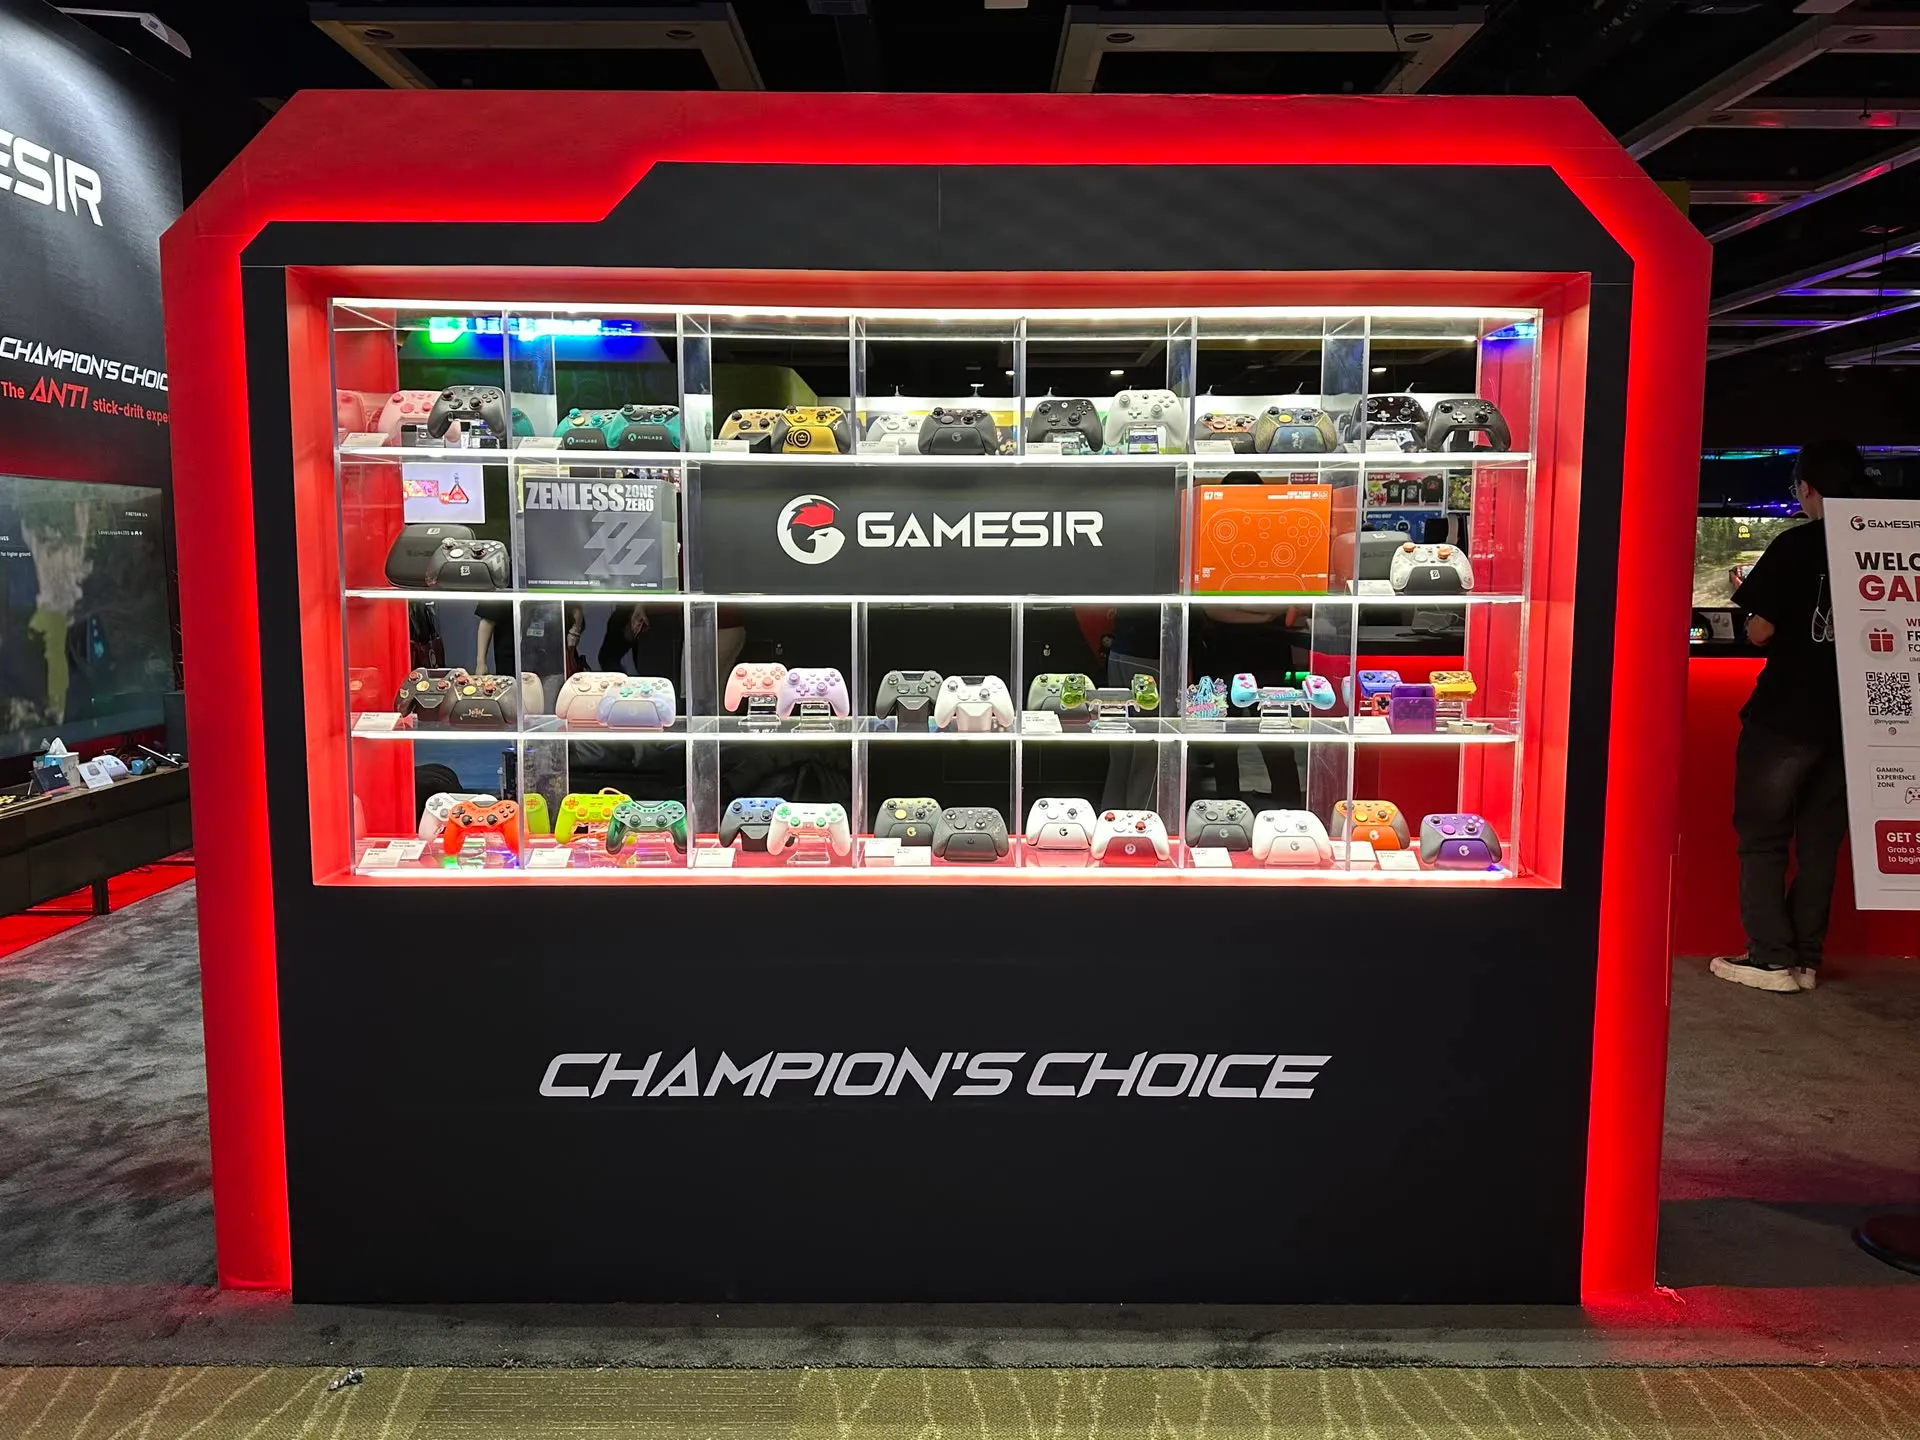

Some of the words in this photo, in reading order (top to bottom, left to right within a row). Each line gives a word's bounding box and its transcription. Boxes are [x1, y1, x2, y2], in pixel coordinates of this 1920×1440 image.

[0, 336, 121, 380] CHAMPION'S
[1, 381, 25, 399] The
[30, 376, 89, 409] ANTI
[93, 398, 144, 419] stick-drift
[146, 409, 170, 425] expe
[525, 481, 625, 512] ZENLESS
[625, 484, 655, 498] ZONE
[625, 498, 654, 512] ZERO
[857, 511, 1104, 548] GAMESIR
[1867, 519, 1920, 529] GAMESIR
[1859, 574, 1920, 602] GA
[1886, 832, 1911, 843] GET
[1887, 846, 1907, 854] Grab
[1888, 855, 1896, 863] to
[539, 1046, 1026, 1102] CHAMPION'S
[1026, 1050, 1332, 1100] CHOICE
